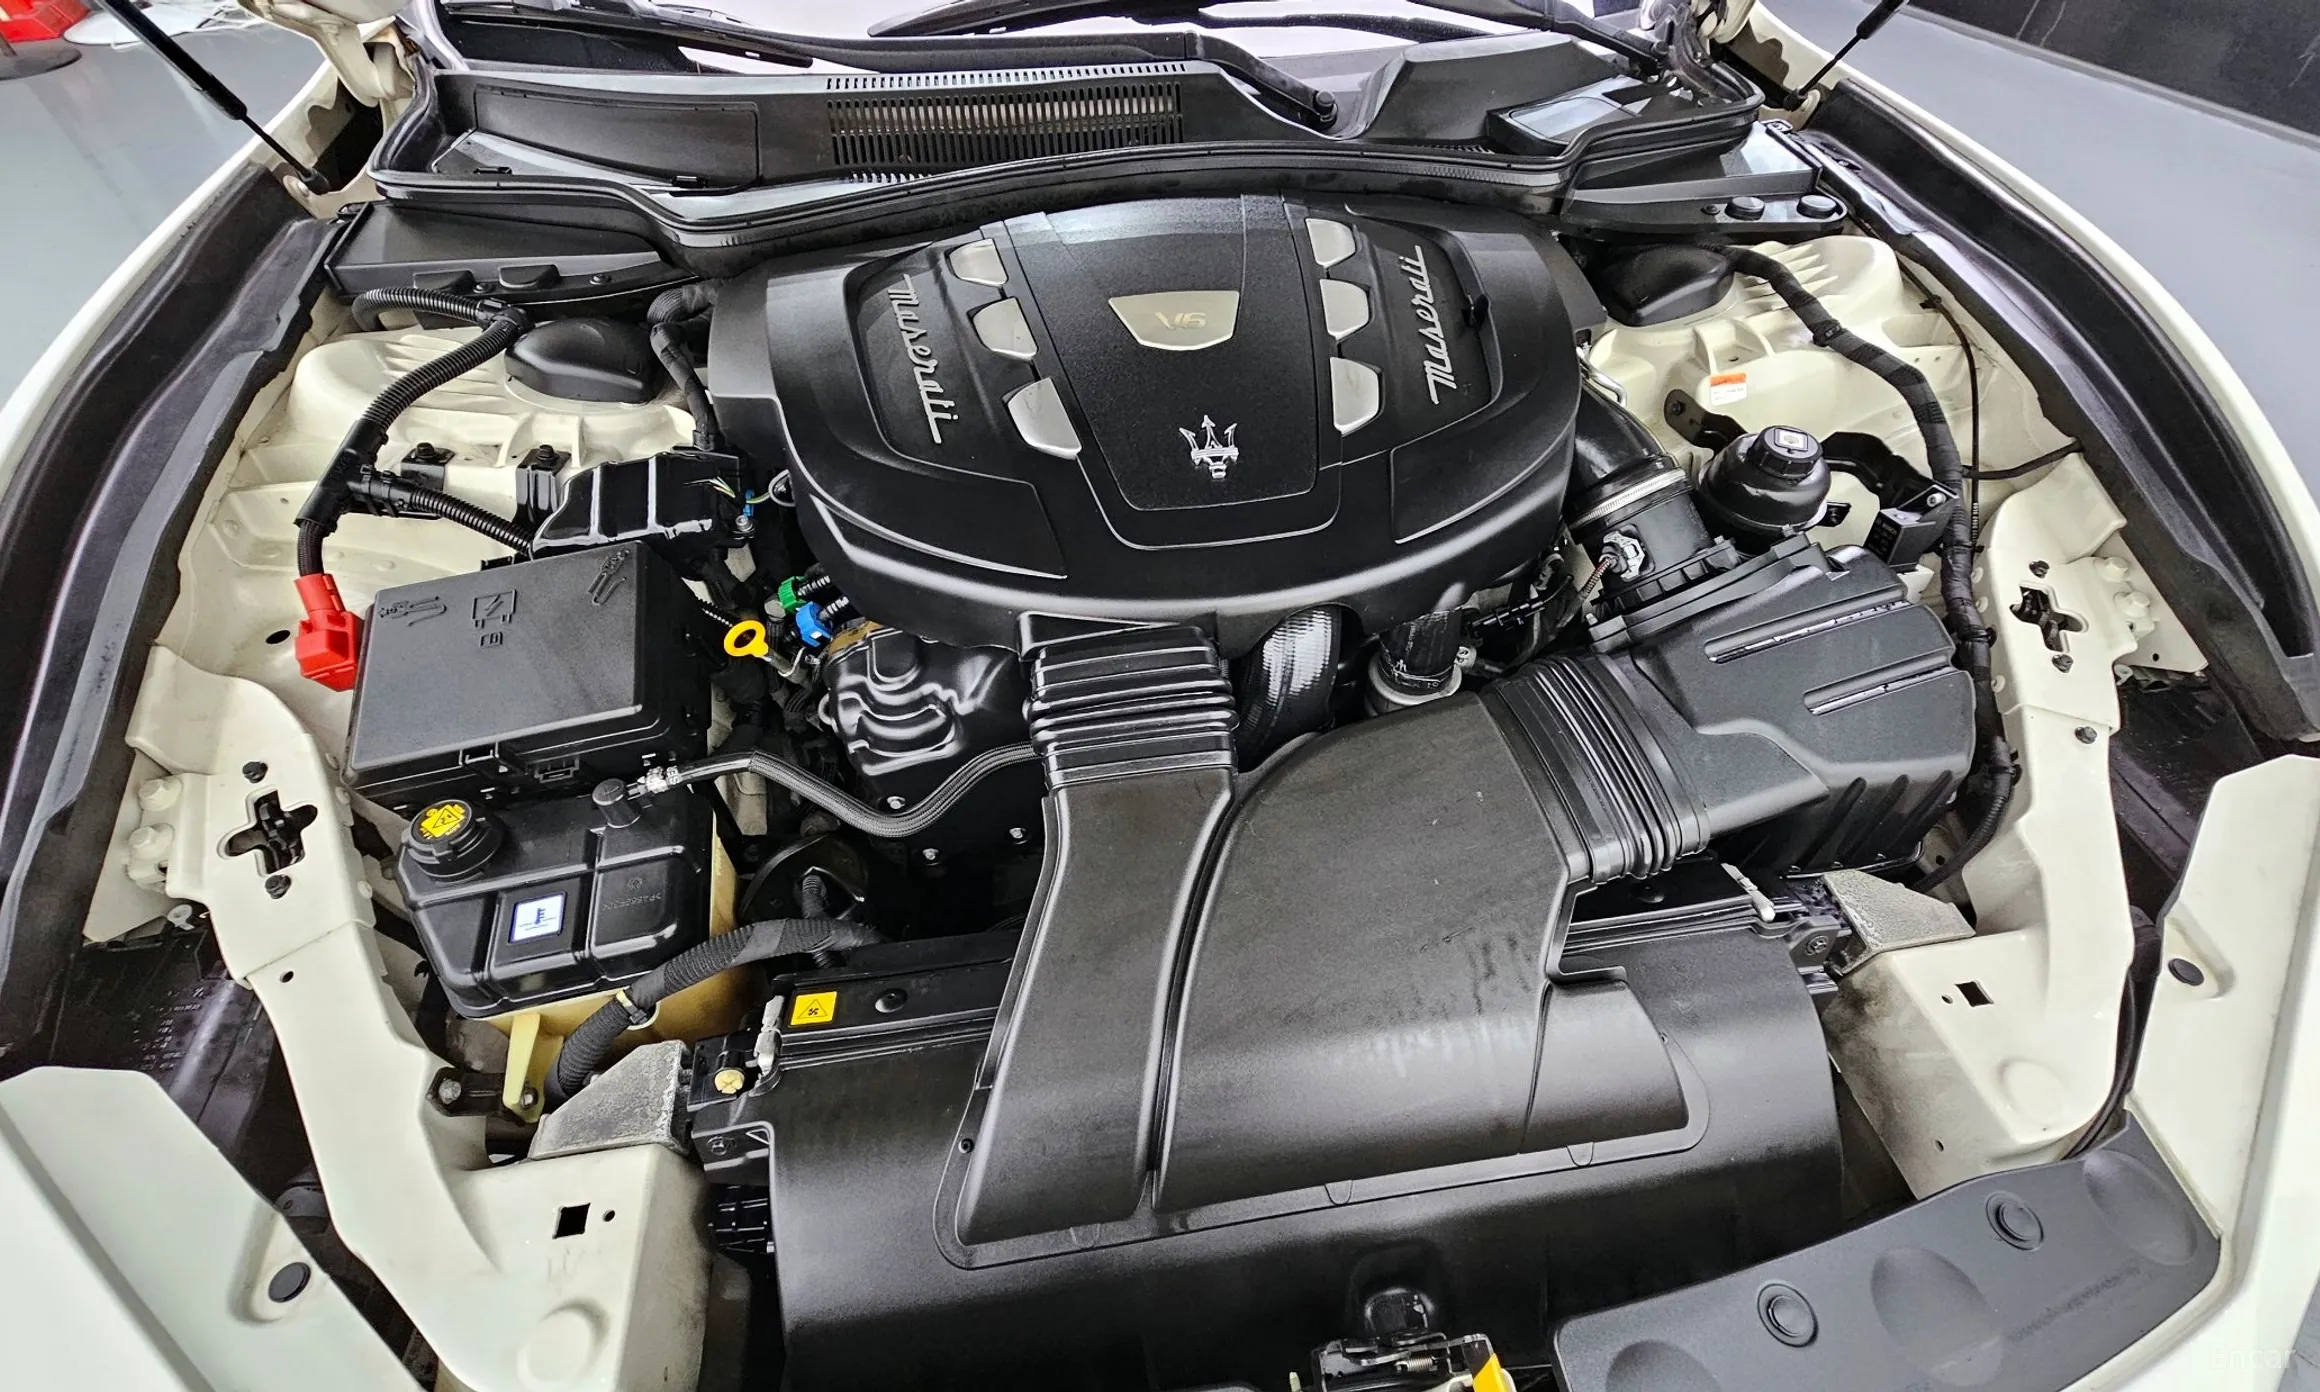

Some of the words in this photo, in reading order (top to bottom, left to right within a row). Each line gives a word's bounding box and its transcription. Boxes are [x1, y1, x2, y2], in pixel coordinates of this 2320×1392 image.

[888, 273, 958, 443] Maserati
[1155, 311, 1206, 330] V6
[1399, 245, 1457, 404] Maserati
